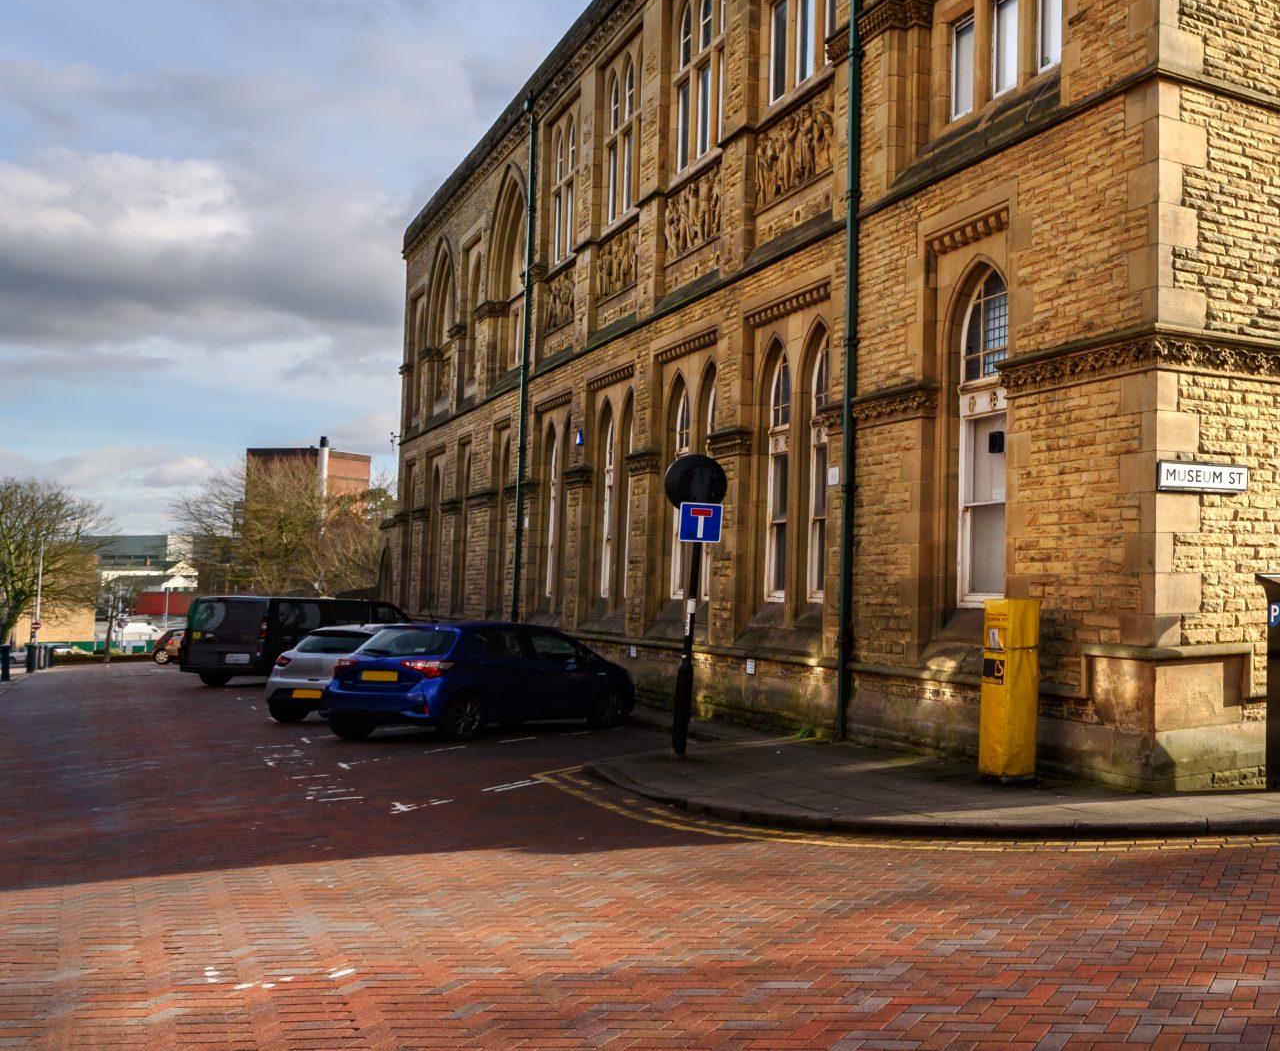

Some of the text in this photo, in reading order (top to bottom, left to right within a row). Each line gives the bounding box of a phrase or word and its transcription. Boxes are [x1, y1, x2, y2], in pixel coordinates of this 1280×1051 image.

[1166, 468, 1244, 485] MUSEUM ST
[1270, 604, 1279, 623] P
